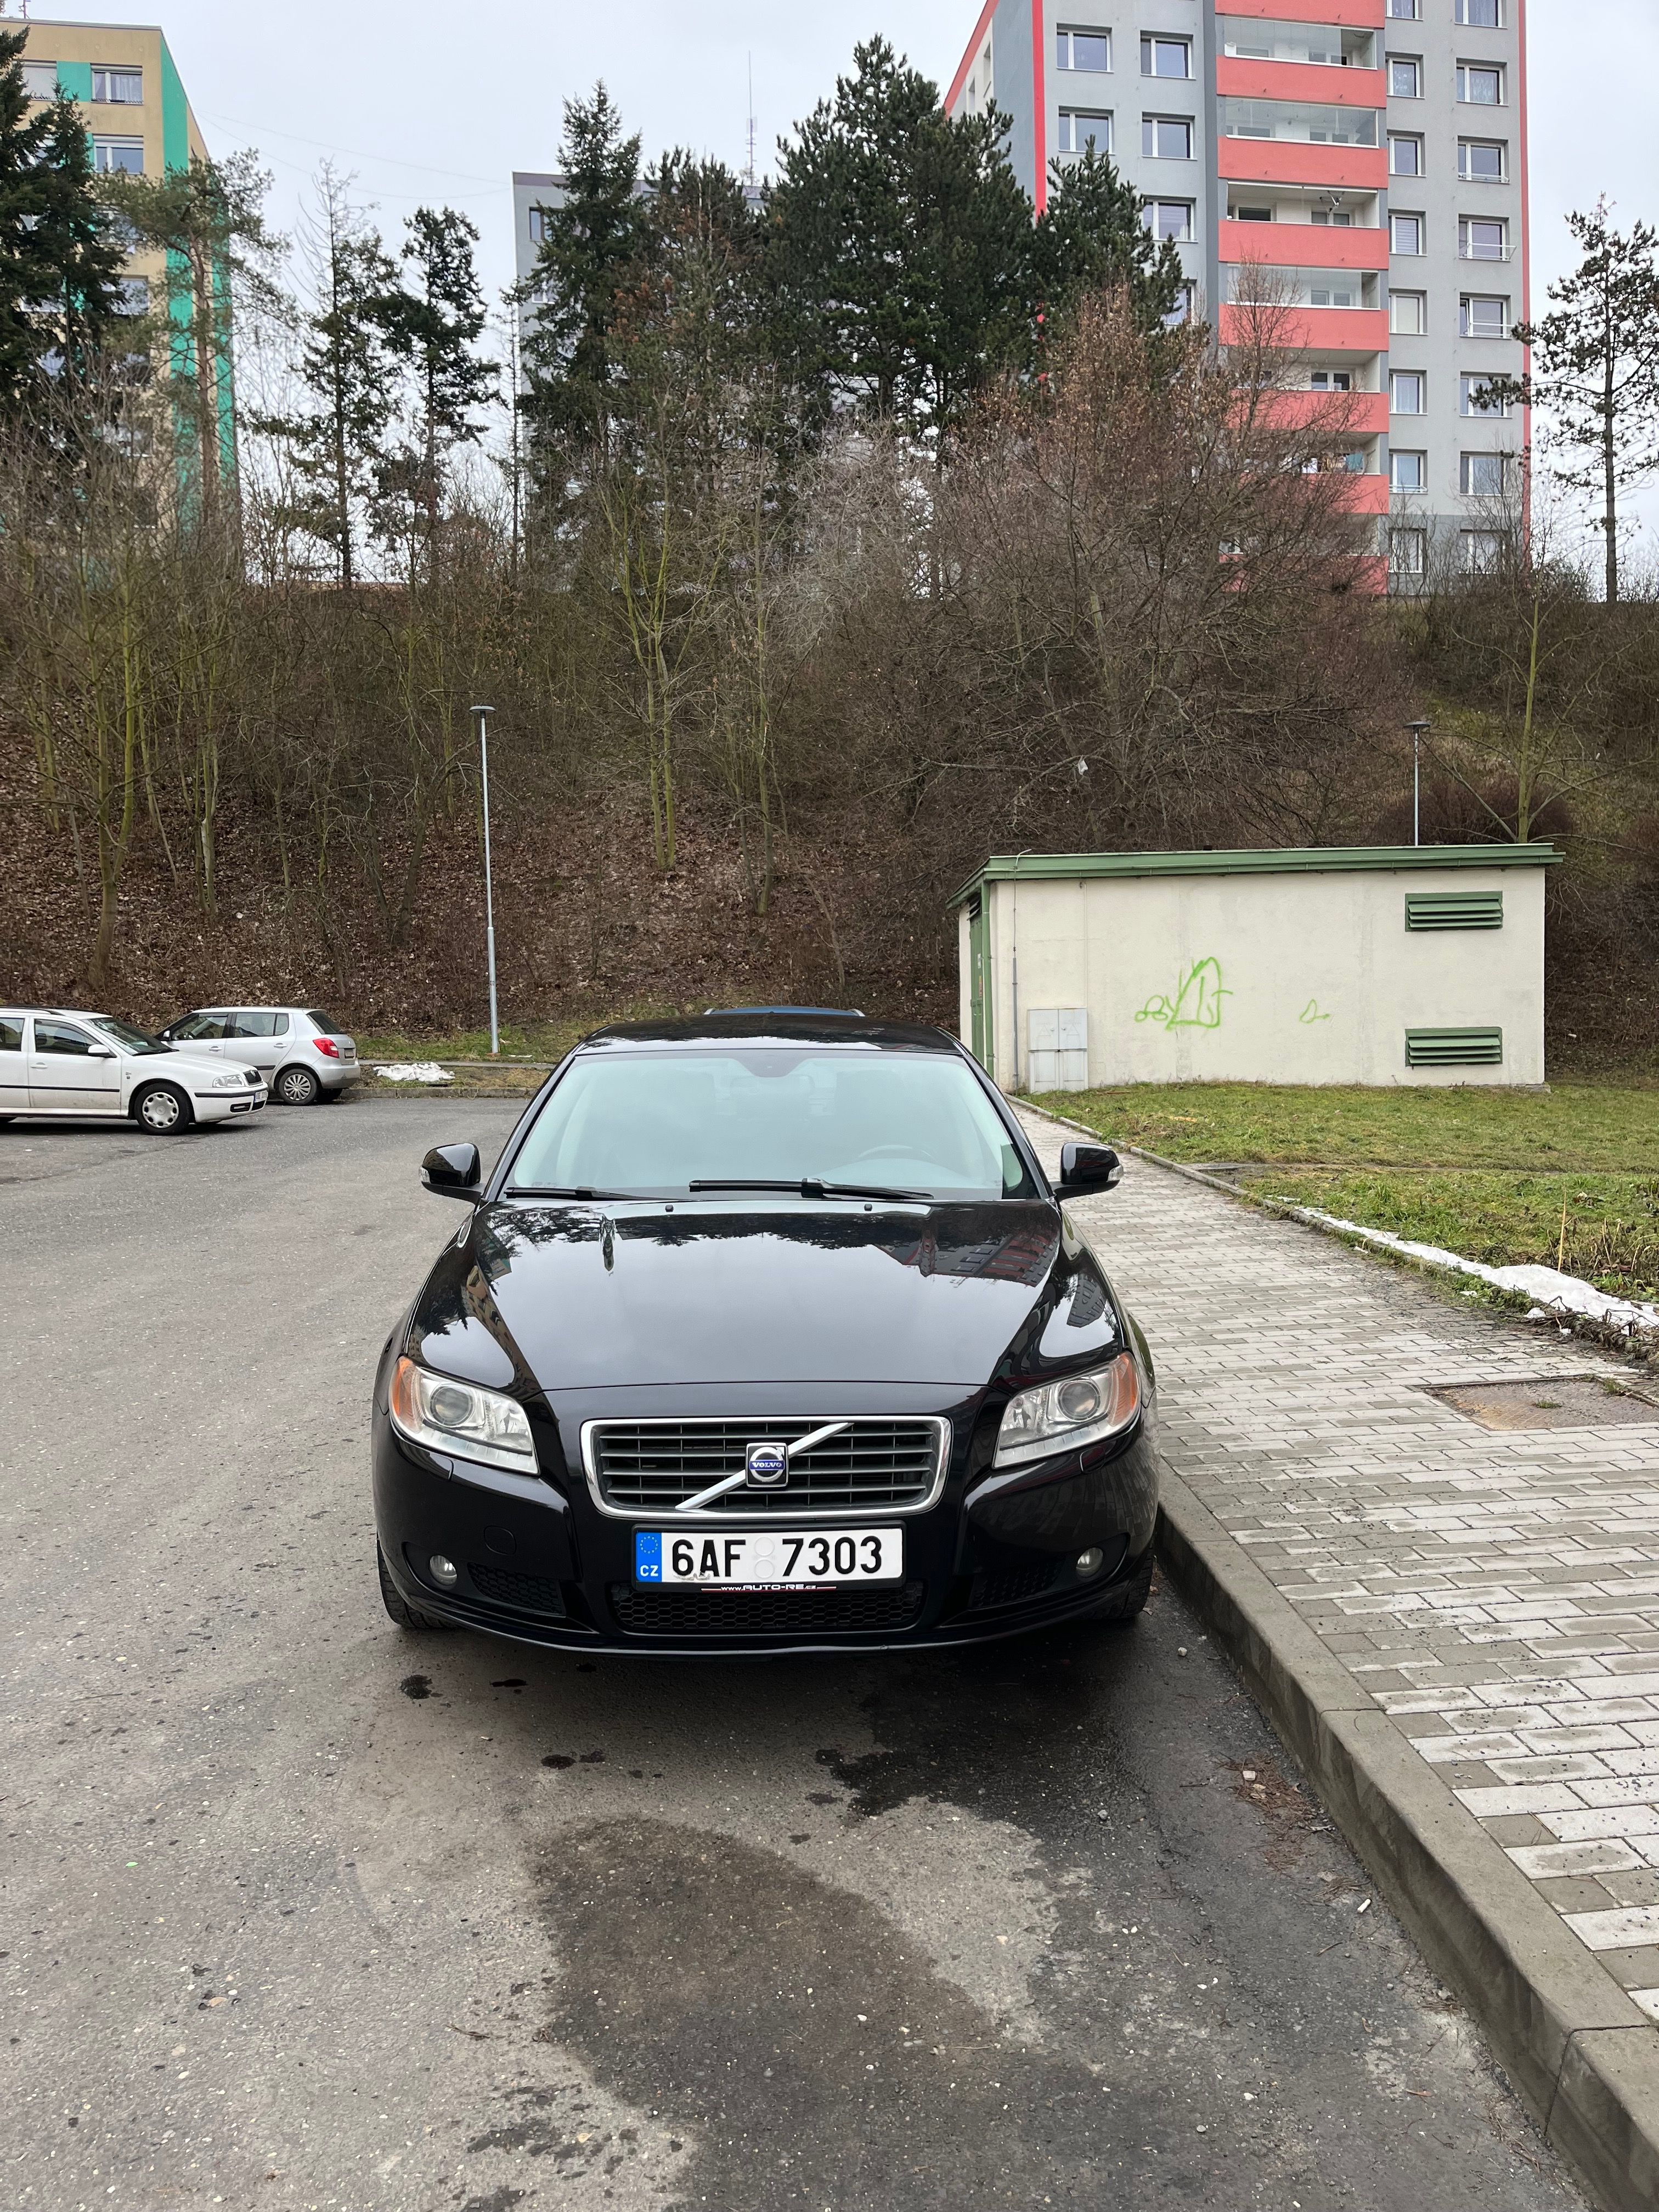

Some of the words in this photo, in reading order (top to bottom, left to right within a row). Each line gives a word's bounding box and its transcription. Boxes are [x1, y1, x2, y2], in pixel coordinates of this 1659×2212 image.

[673, 1539, 746, 1577] 6AF
[782, 1536, 882, 1577] 7303
[640, 1565, 658, 1577] CZ
